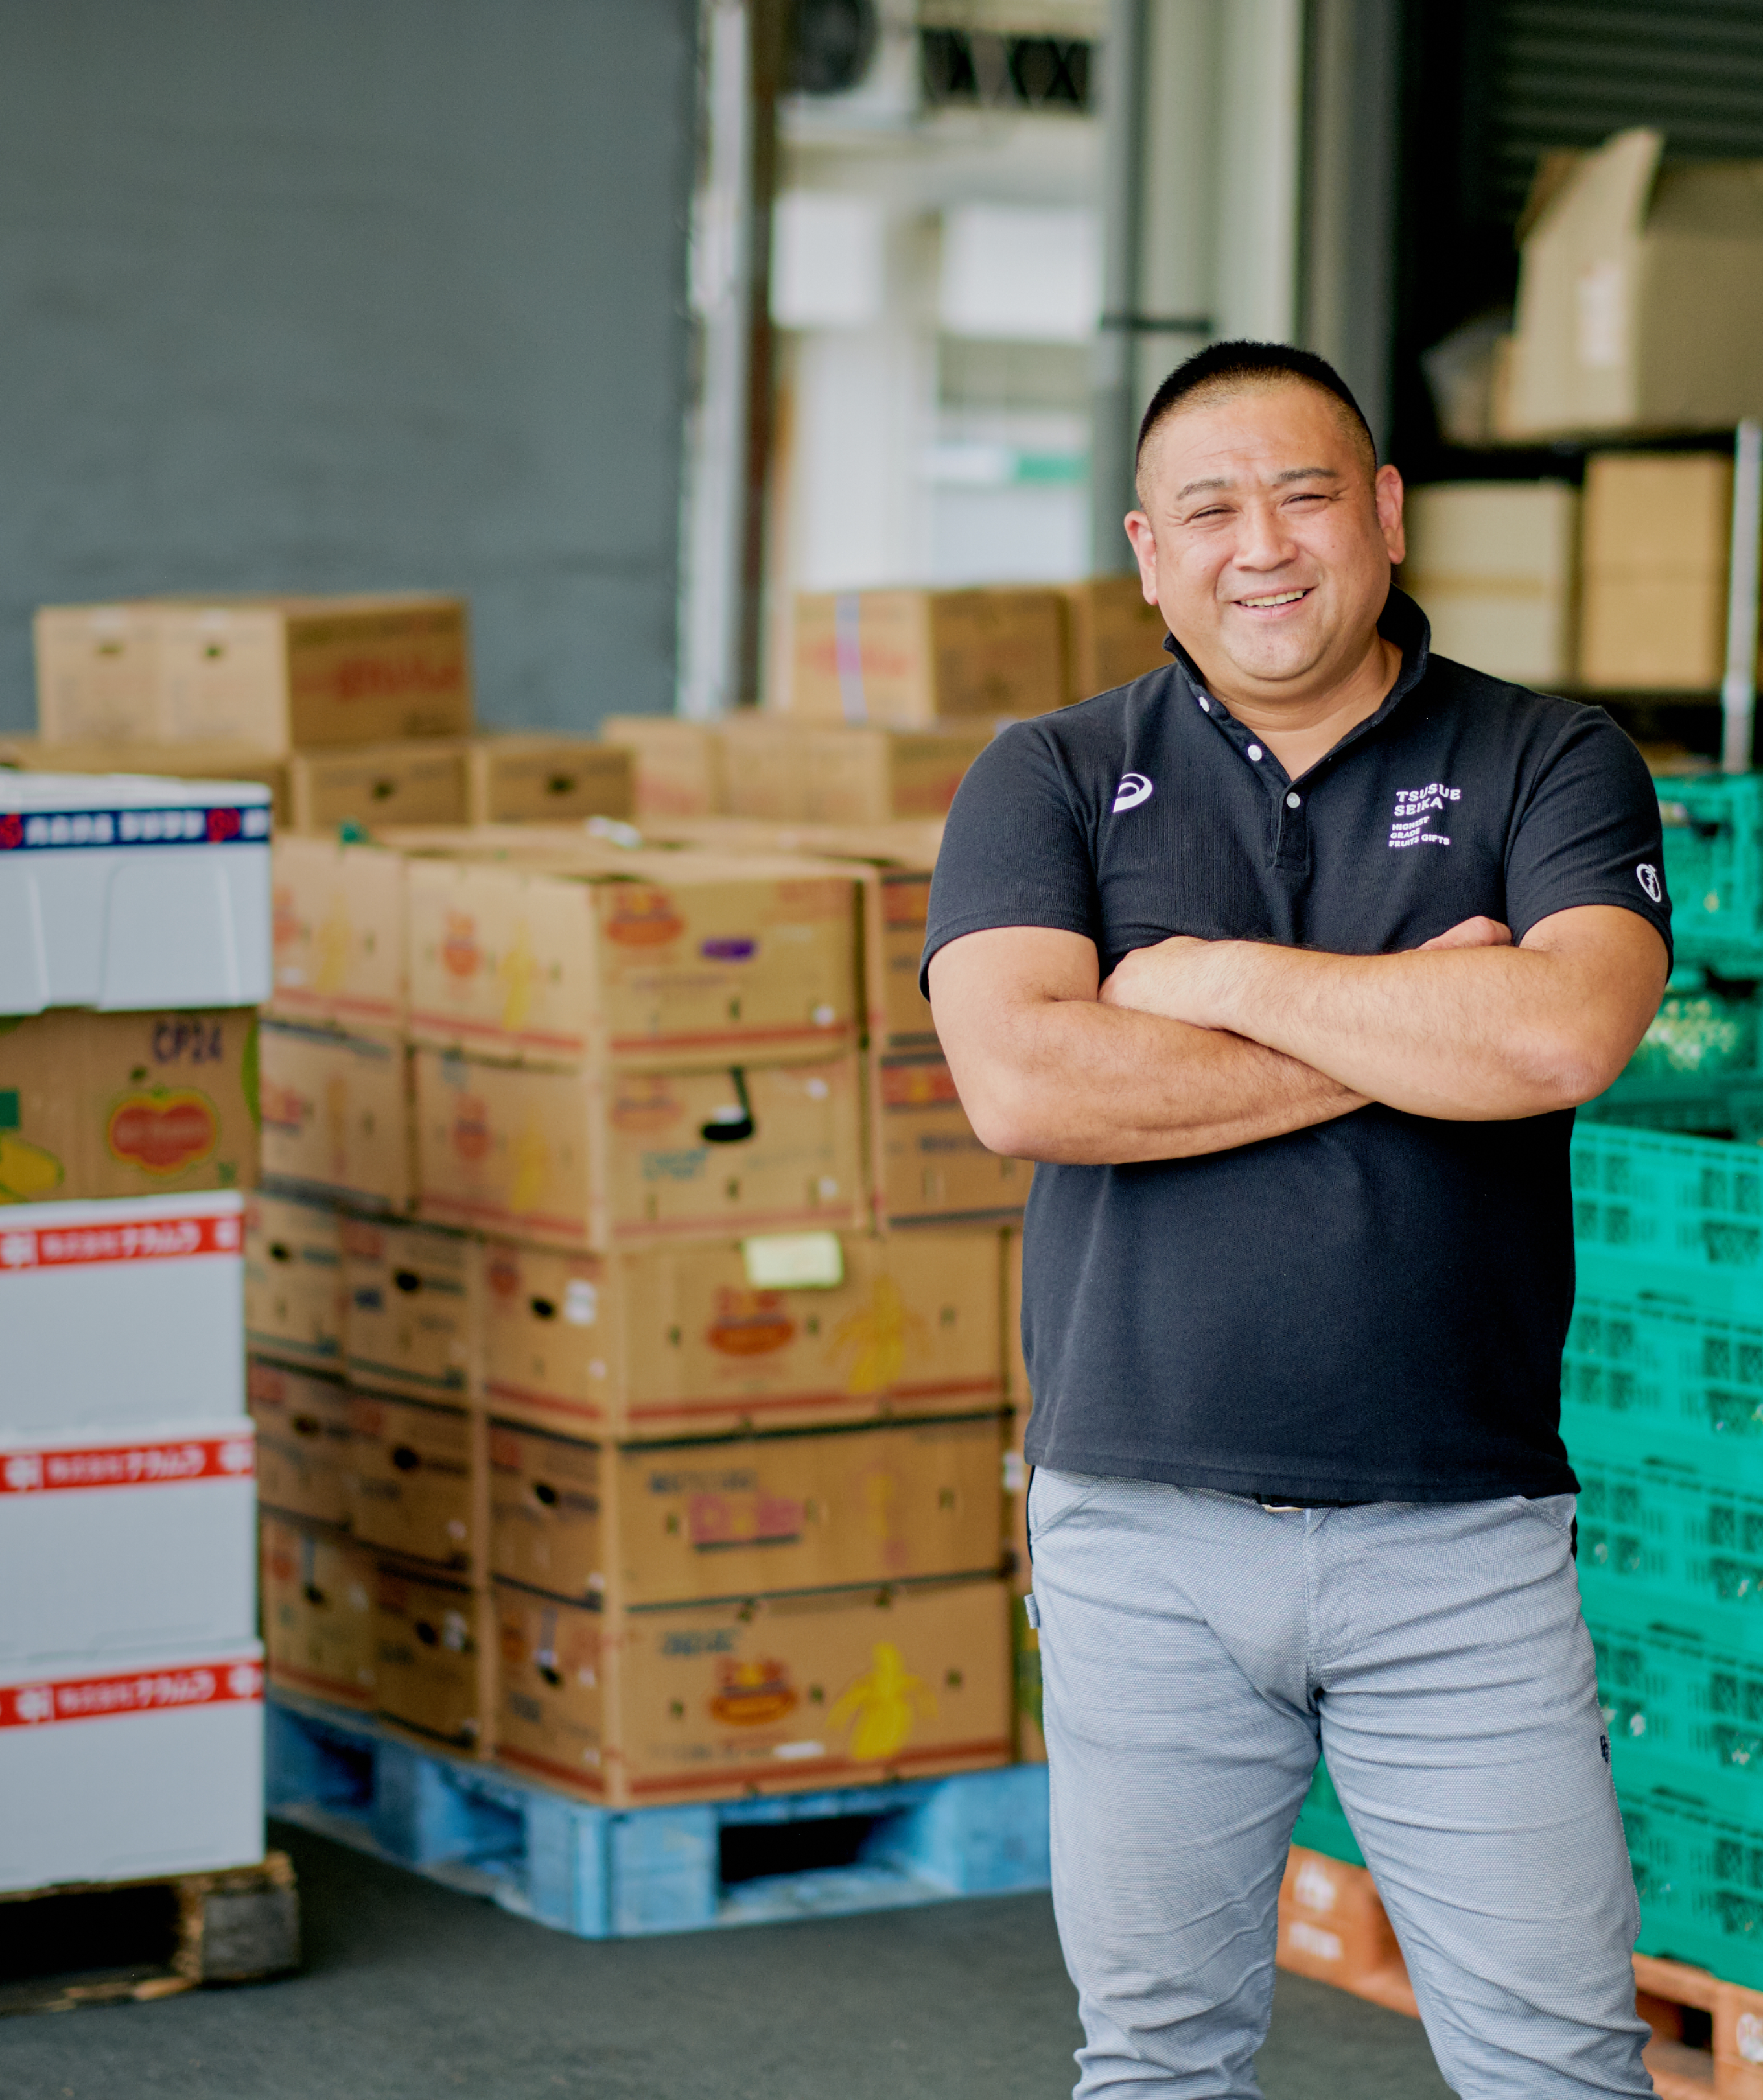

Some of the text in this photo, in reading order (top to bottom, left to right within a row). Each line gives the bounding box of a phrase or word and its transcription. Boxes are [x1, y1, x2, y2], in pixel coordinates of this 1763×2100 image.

[1395, 782, 1462, 802] TSUSUE
[1394, 796, 1443, 817] SEIKA
[1392, 816, 1430, 831] HIGHEST
[1388, 834, 1451, 847] FRUITS GIFTS
[1390, 827, 1420, 839] GRADE
